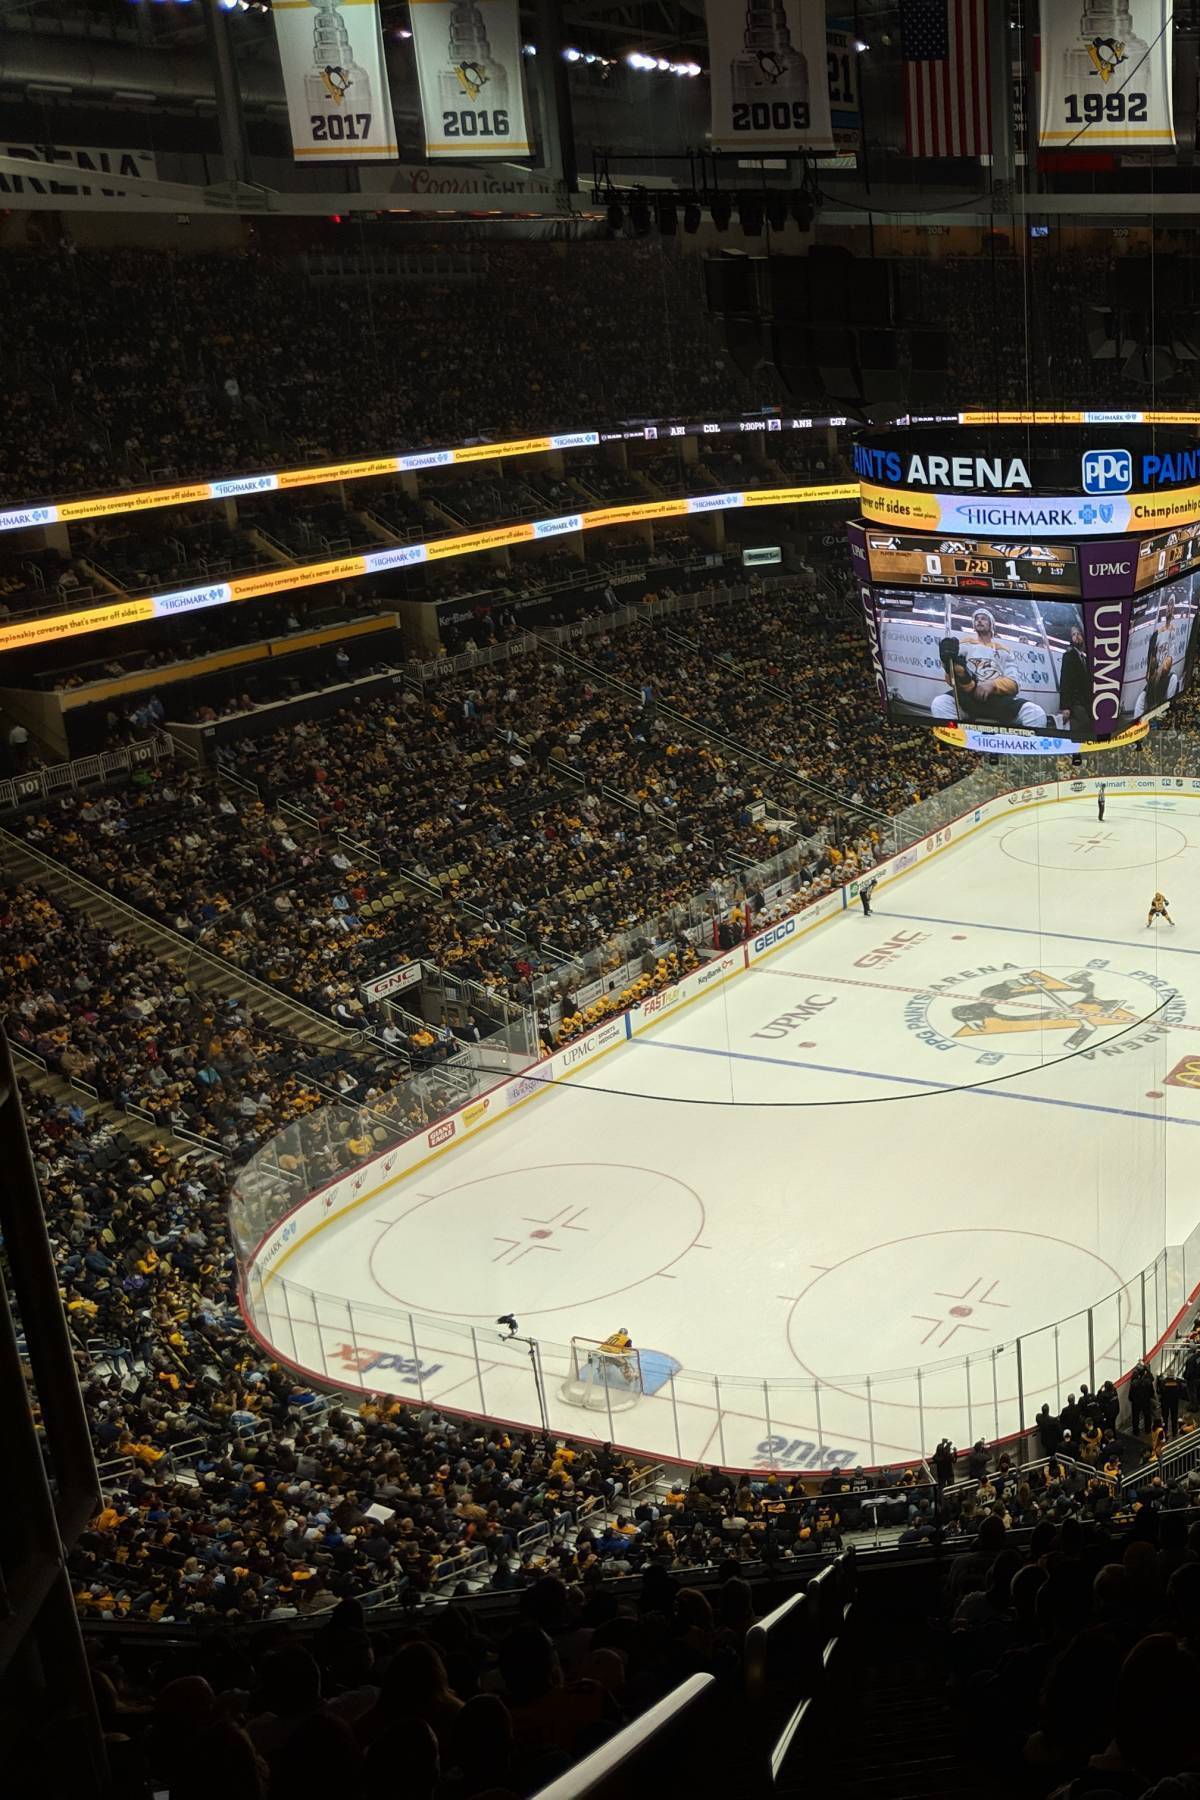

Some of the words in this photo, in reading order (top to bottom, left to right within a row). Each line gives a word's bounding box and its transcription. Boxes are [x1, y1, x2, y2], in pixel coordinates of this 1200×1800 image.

[733, 102, 810, 130] 2009
[1064, 93, 1148, 123] 1992
[311, 114, 372, 141] 2017
[443, 110, 509, 137] 2016
[670, 426, 685, 436] ARI
[703, 424, 720, 433] COL
[740, 422, 765, 431] 9:00PM
[792, 419, 813, 428] ANH
[830, 417, 847, 426] CGY
[906, 454, 1033, 488] ARENA
[1086, 454, 1130, 489] PPG
[874, 497, 886, 512] off
[886, 498, 911, 516] sides
[967, 507, 1074, 527] HIGHMARK
[1135, 500, 1197, 519] Championship
[374, 553, 409, 567] HIGHMARK
[926, 554, 942, 575] 0
[964, 559, 989, 573] 7:29
[1005, 560, 1021, 581] 1
[1088, 561, 1131, 577] UPMC
[36, 622, 69, 635] coverage
[69, 616, 89, 629] that's
[90, 614, 110, 625] never
[110, 610, 120, 621] off
[121, 607, 138, 619] sides
[165, 593, 209, 610] HIGHMARK
[1092, 601, 1123, 721] UPMC
[976, 736, 1037, 751] HIGHMARK
[999, 726, 1036, 737] ELECTRIC
[754, 918, 796, 953] GEICO
[854, 930, 923, 968] GNC
[374, 968, 415, 993] GNC
[697, 966, 722, 985] KeyBank
[929, 962, 1019, 992] ARENA
[1128, 970, 1167, 988] PPG
[751, 994, 837, 1041] UPMC
[904, 994, 931, 1031] PAINTS
[563, 1035, 596, 1067] UPMC
[915, 1032, 959, 1051] PPG
[431, 1123, 453, 1139] GIANT
[431, 1130, 453, 1146] EAGLE
[328, 1343, 444, 1385] FedEx
